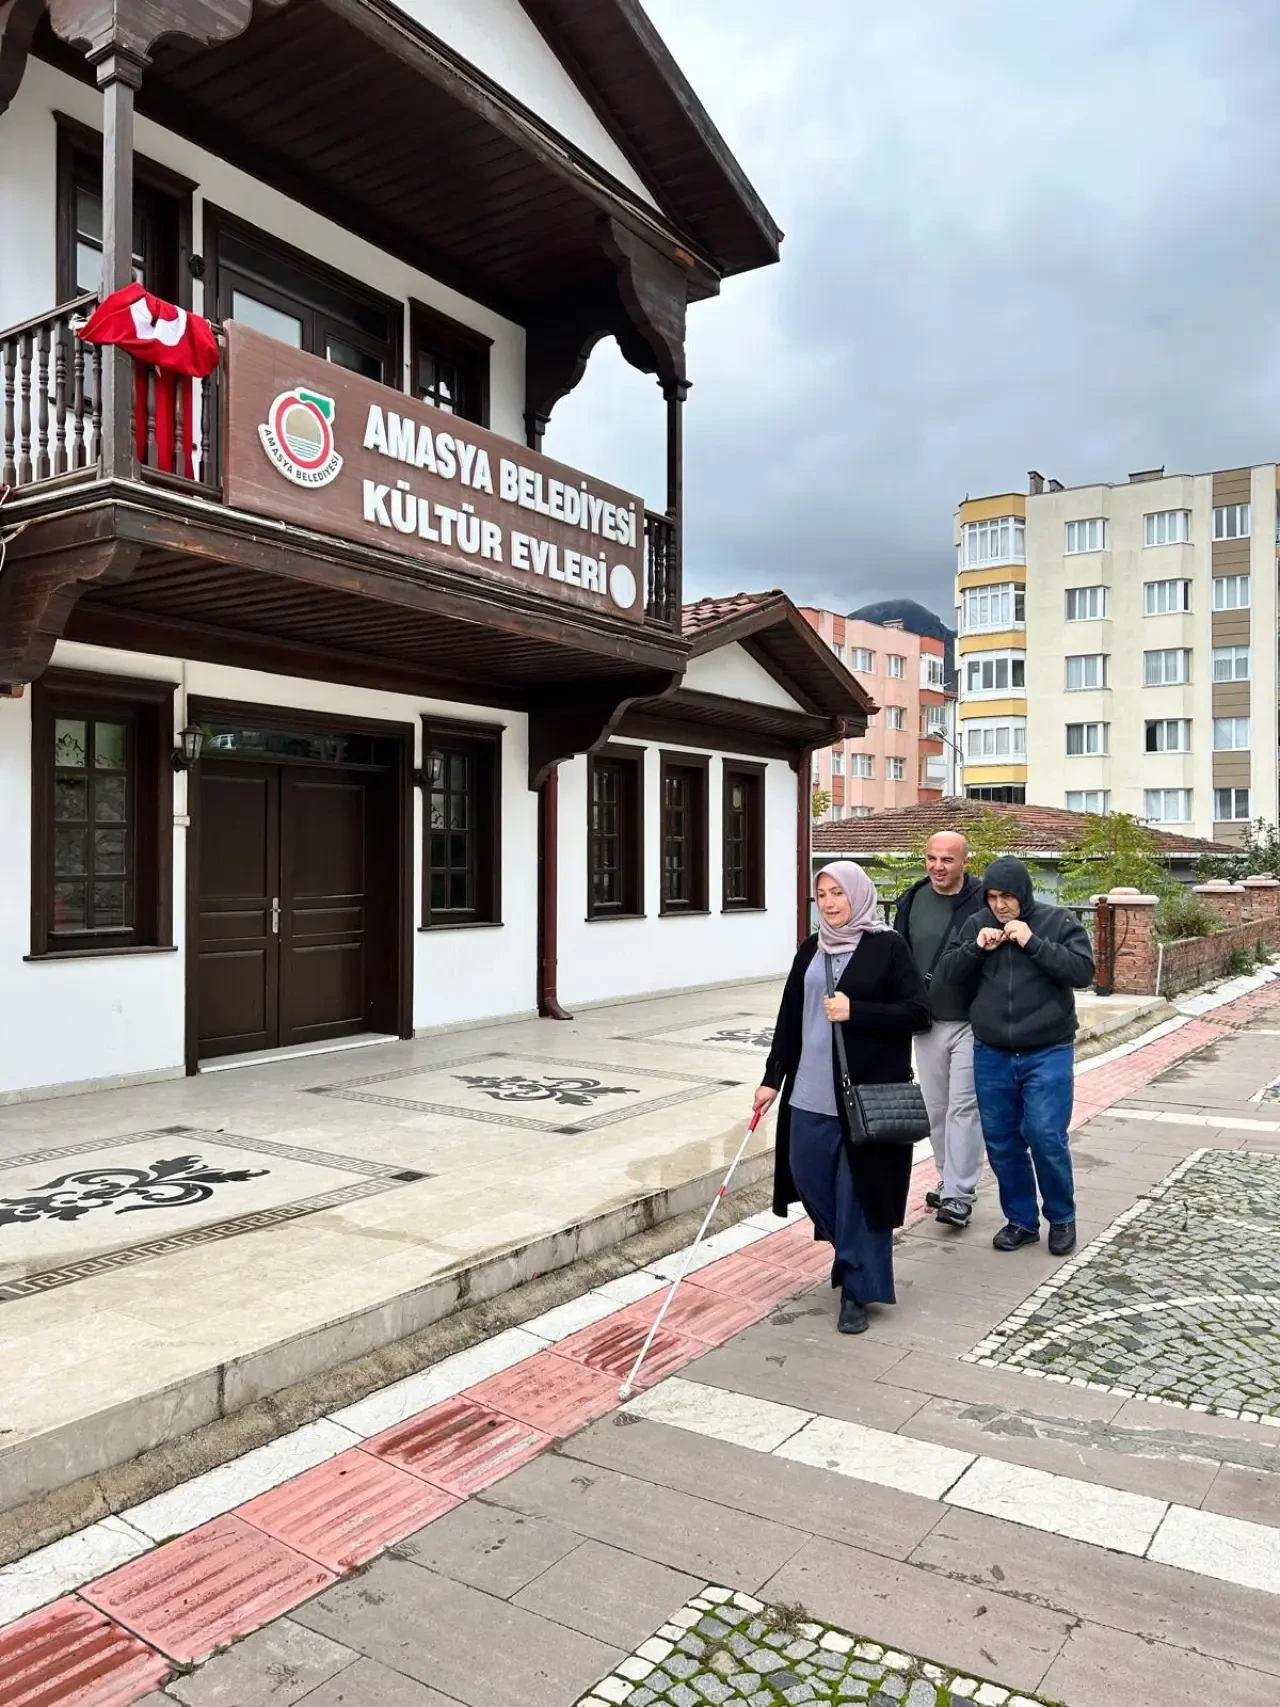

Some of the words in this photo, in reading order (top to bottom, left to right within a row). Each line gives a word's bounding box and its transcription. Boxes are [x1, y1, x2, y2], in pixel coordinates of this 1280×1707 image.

[265, 429, 293, 473] AMASYA
[364, 405, 493, 494] AMASYA
[500, 458, 637, 547] BELEDİYESİ
[363, 480, 502, 561] KÜLTÜR
[512, 531, 607, 594] EVLERİ
